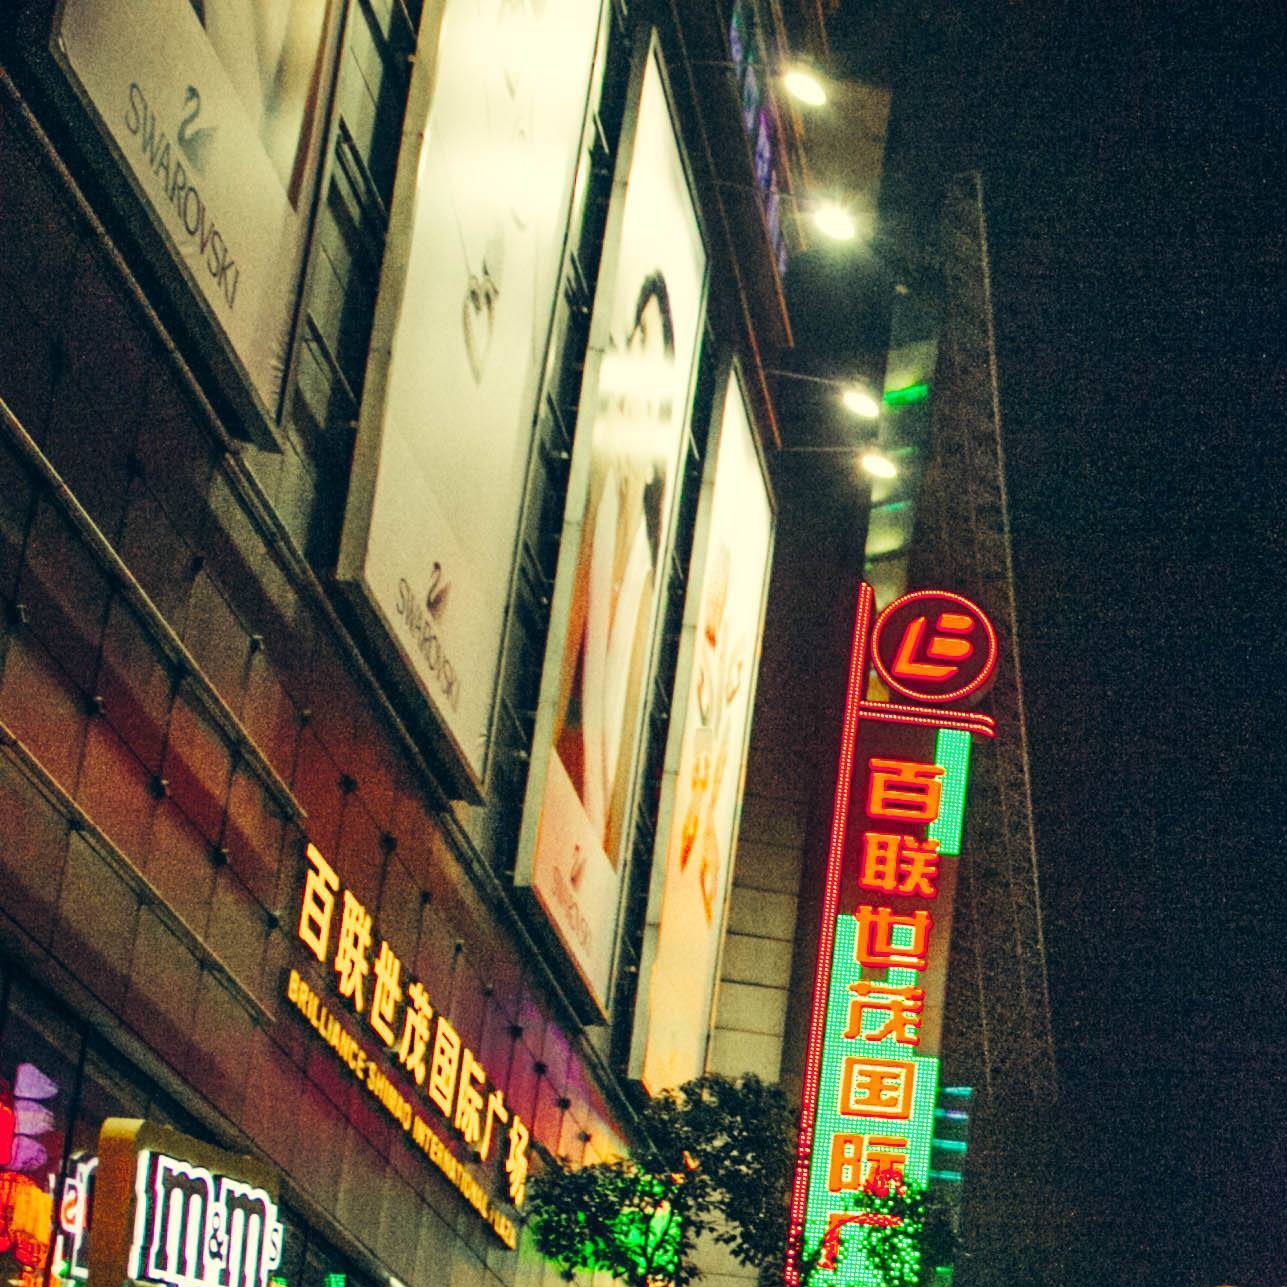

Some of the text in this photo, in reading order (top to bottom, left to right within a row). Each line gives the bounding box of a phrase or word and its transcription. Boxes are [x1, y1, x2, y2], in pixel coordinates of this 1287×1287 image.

[124, 81, 240, 310] SWAROVSKI
[298, 842, 531, 1207] 百联世茂国际广场
